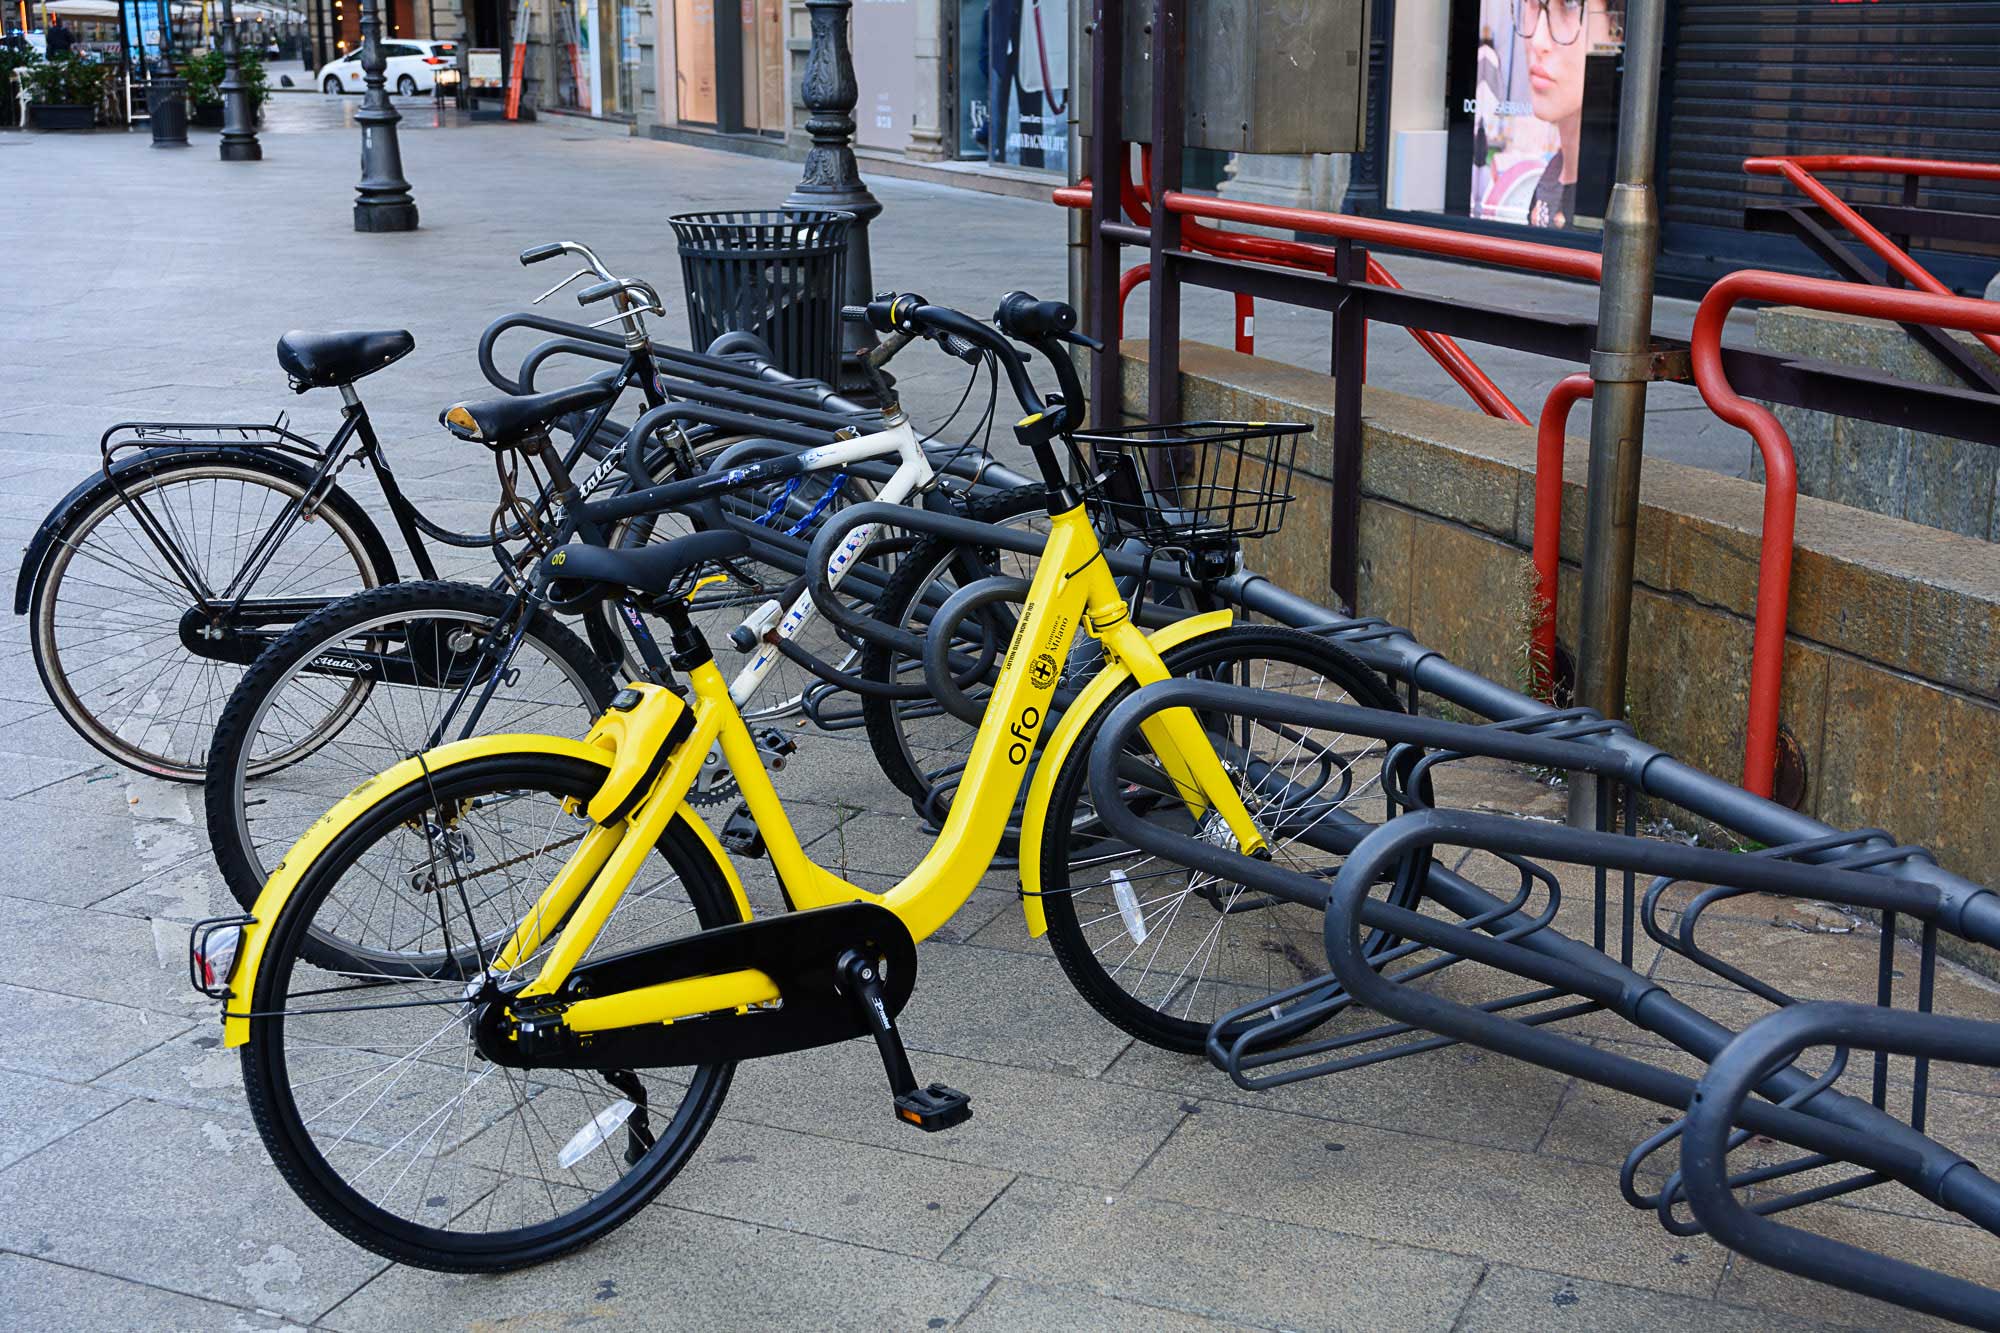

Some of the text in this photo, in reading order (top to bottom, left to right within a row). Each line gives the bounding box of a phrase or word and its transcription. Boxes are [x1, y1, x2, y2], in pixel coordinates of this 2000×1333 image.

[579, 459, 618, 498] tala
[1050, 617, 1069, 652] Milano
[314, 656, 356, 669] Atala
[1008, 706, 1040, 766] ofo
